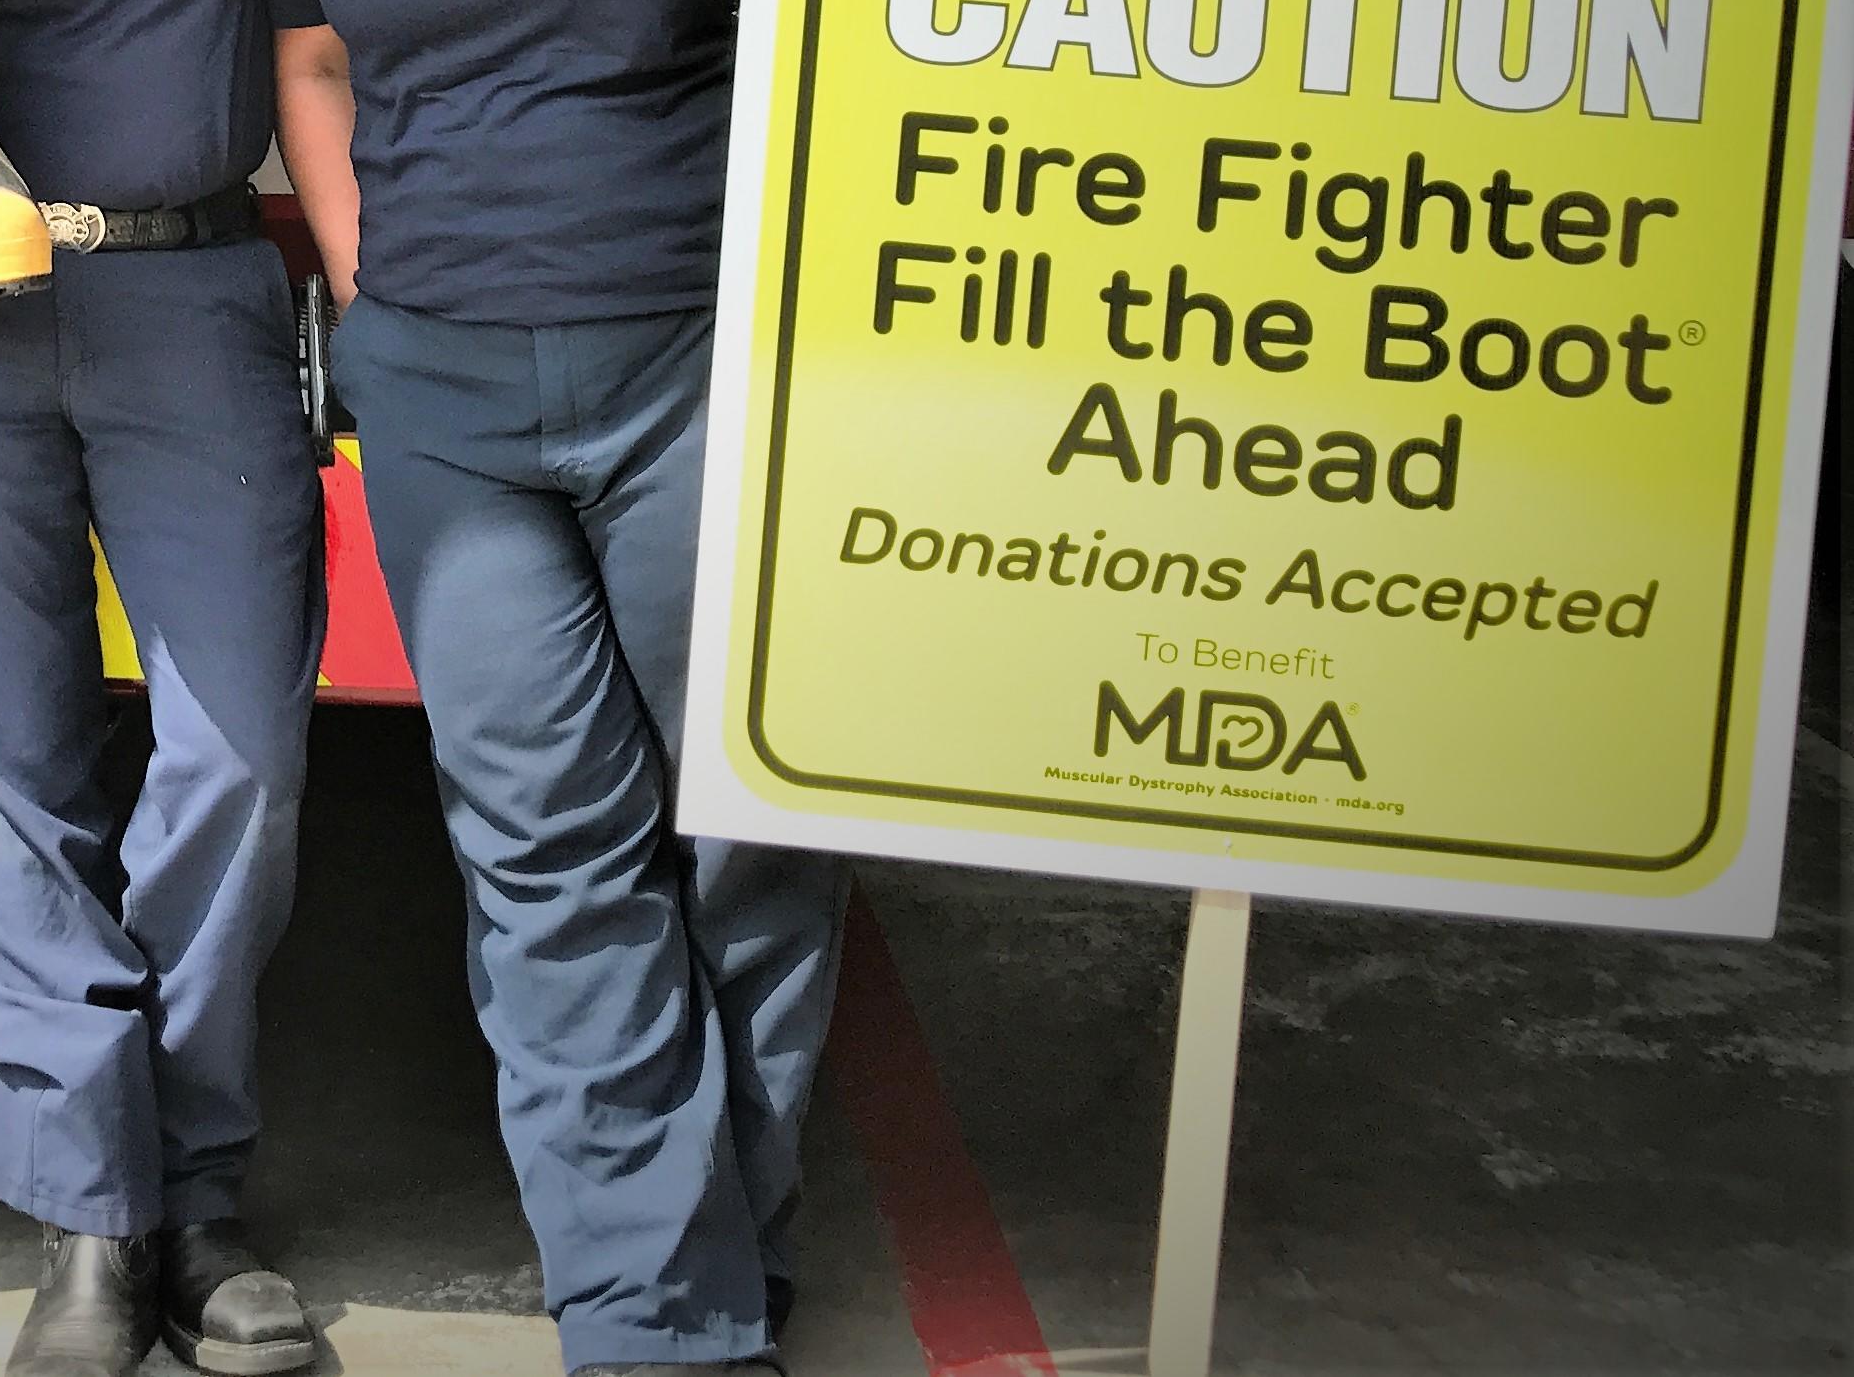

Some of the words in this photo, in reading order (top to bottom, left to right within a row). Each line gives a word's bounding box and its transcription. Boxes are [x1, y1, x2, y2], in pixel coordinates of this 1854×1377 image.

[895, 111, 1146, 226] Fire
[1196, 137, 1680, 275] Fighter
[872, 240, 1052, 350] Fill
[1099, 263, 1314, 374] the
[1046, 382, 1463, 512] Ahead
[839, 507, 1247, 603] Donations
[1264, 548, 1659, 642] Accepted
[1135, 632, 1179, 664] To
[1193, 637, 1335, 680] Benefit
[1044, 766, 1123, 786] Muscular
[1128, 774, 1216, 798] Dystrophy
[1220, 783, 1318, 805] Association
[1336, 795, 1405, 816] mda.org
